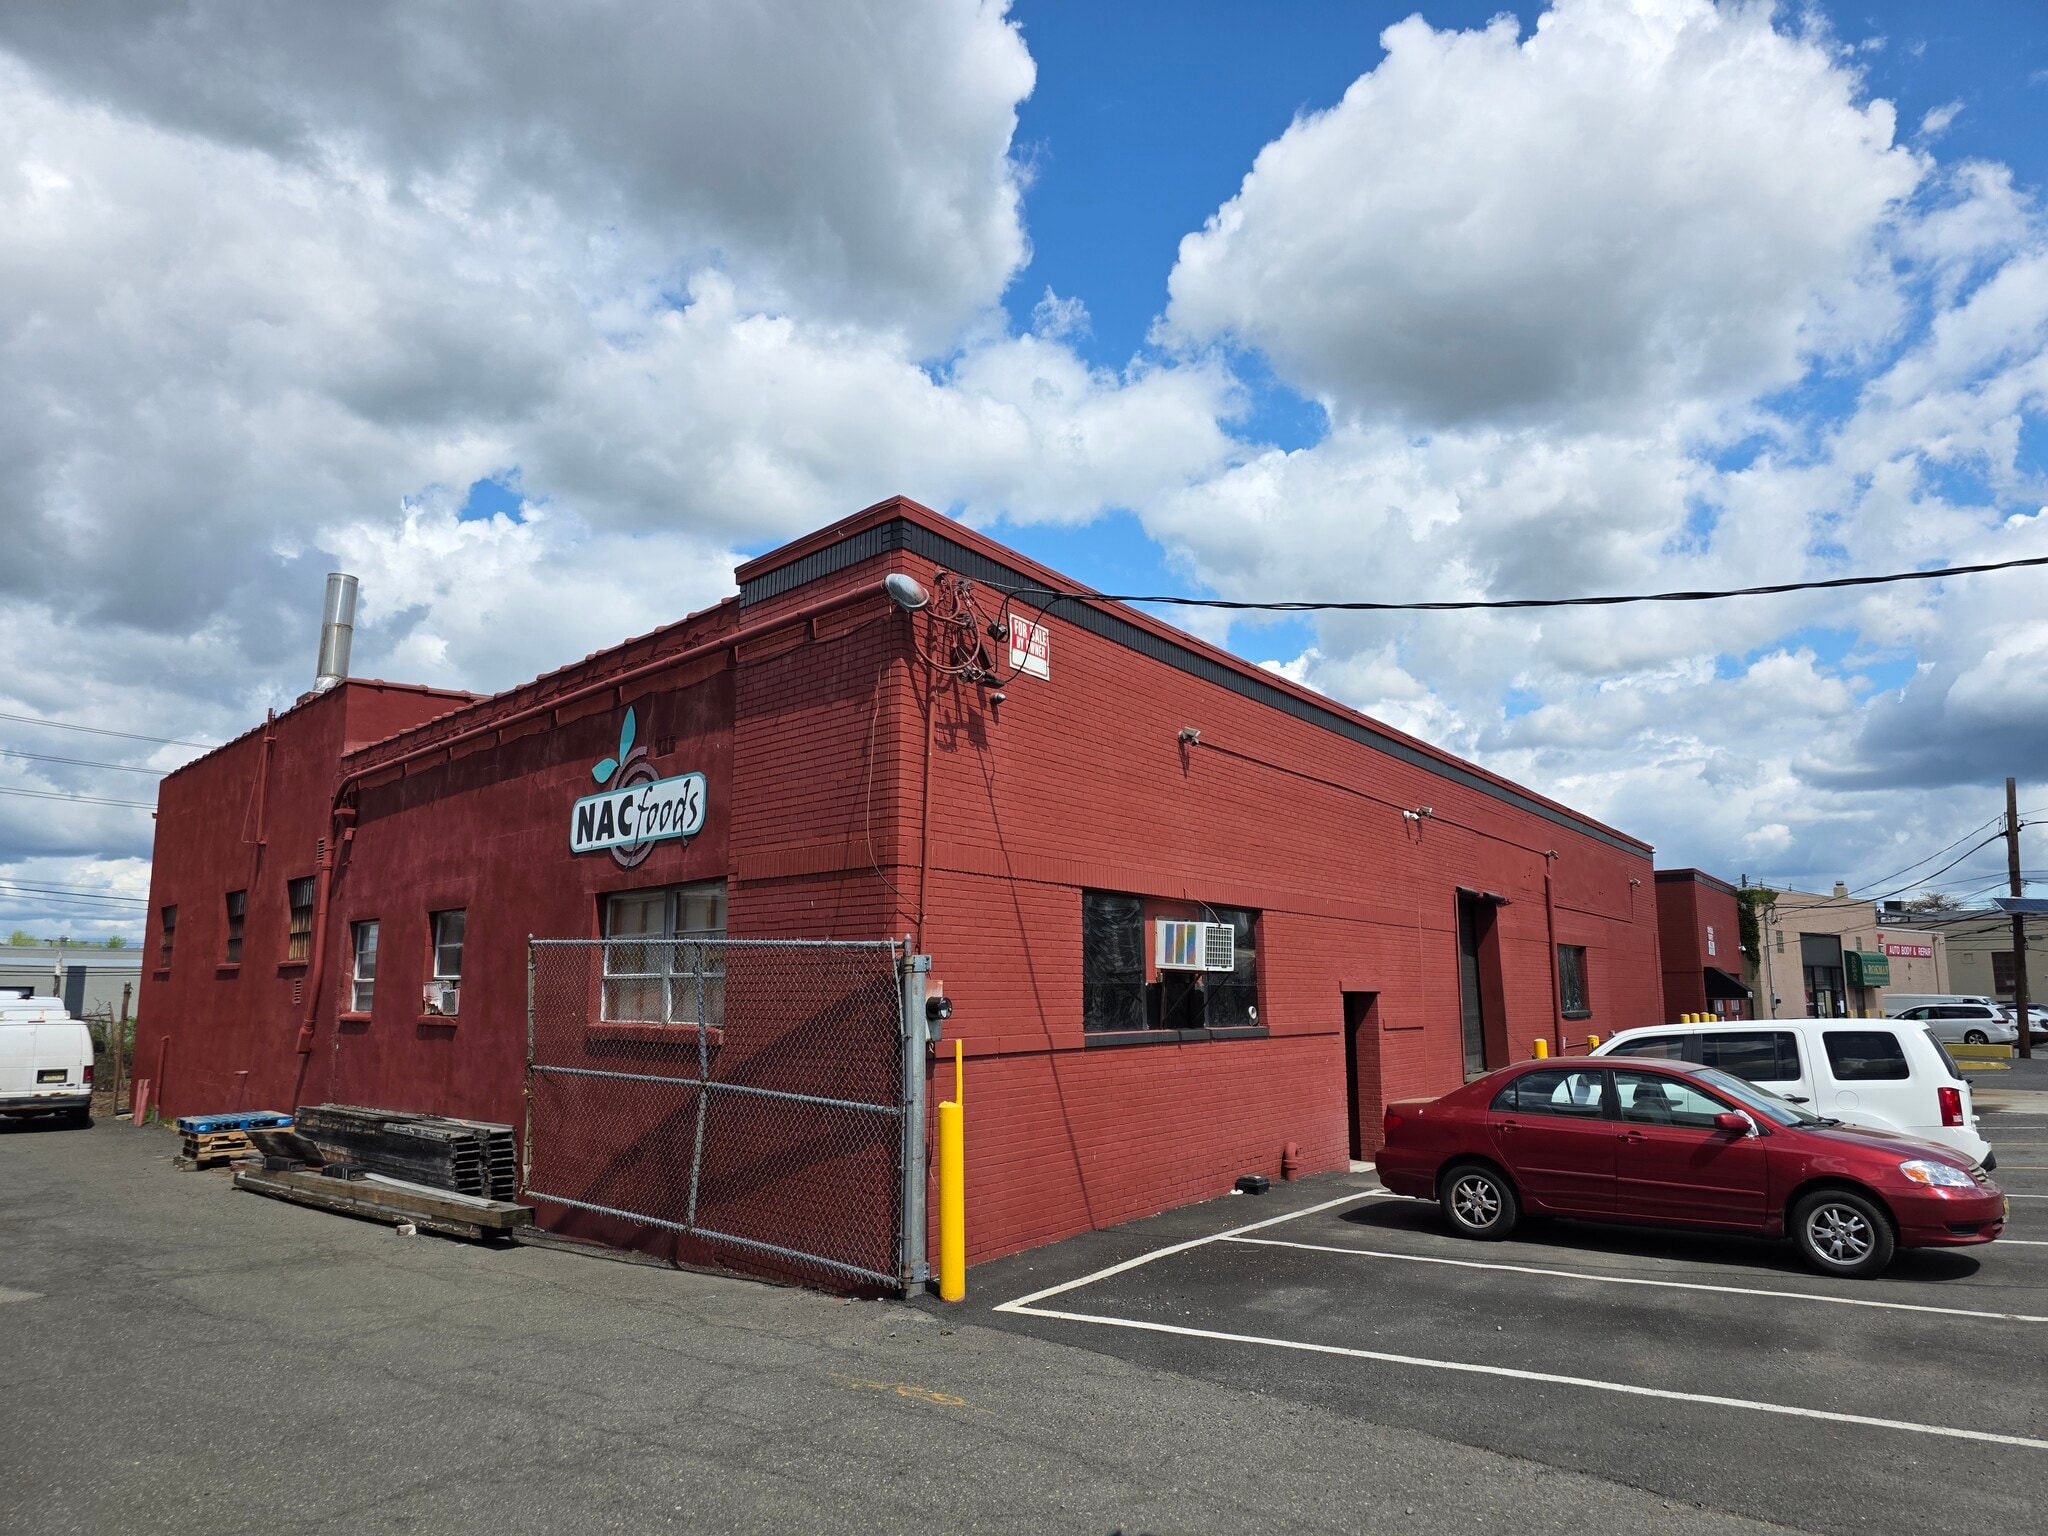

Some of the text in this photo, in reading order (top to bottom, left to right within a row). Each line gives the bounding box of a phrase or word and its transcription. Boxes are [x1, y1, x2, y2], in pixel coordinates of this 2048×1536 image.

[1014, 619, 1047, 646] FOR SALE
[1016, 635, 1024, 651] BY
[576, 778, 699, 868] NAC foods
[1889, 945, 1931, 956] AUTO BODY & REPAIR
